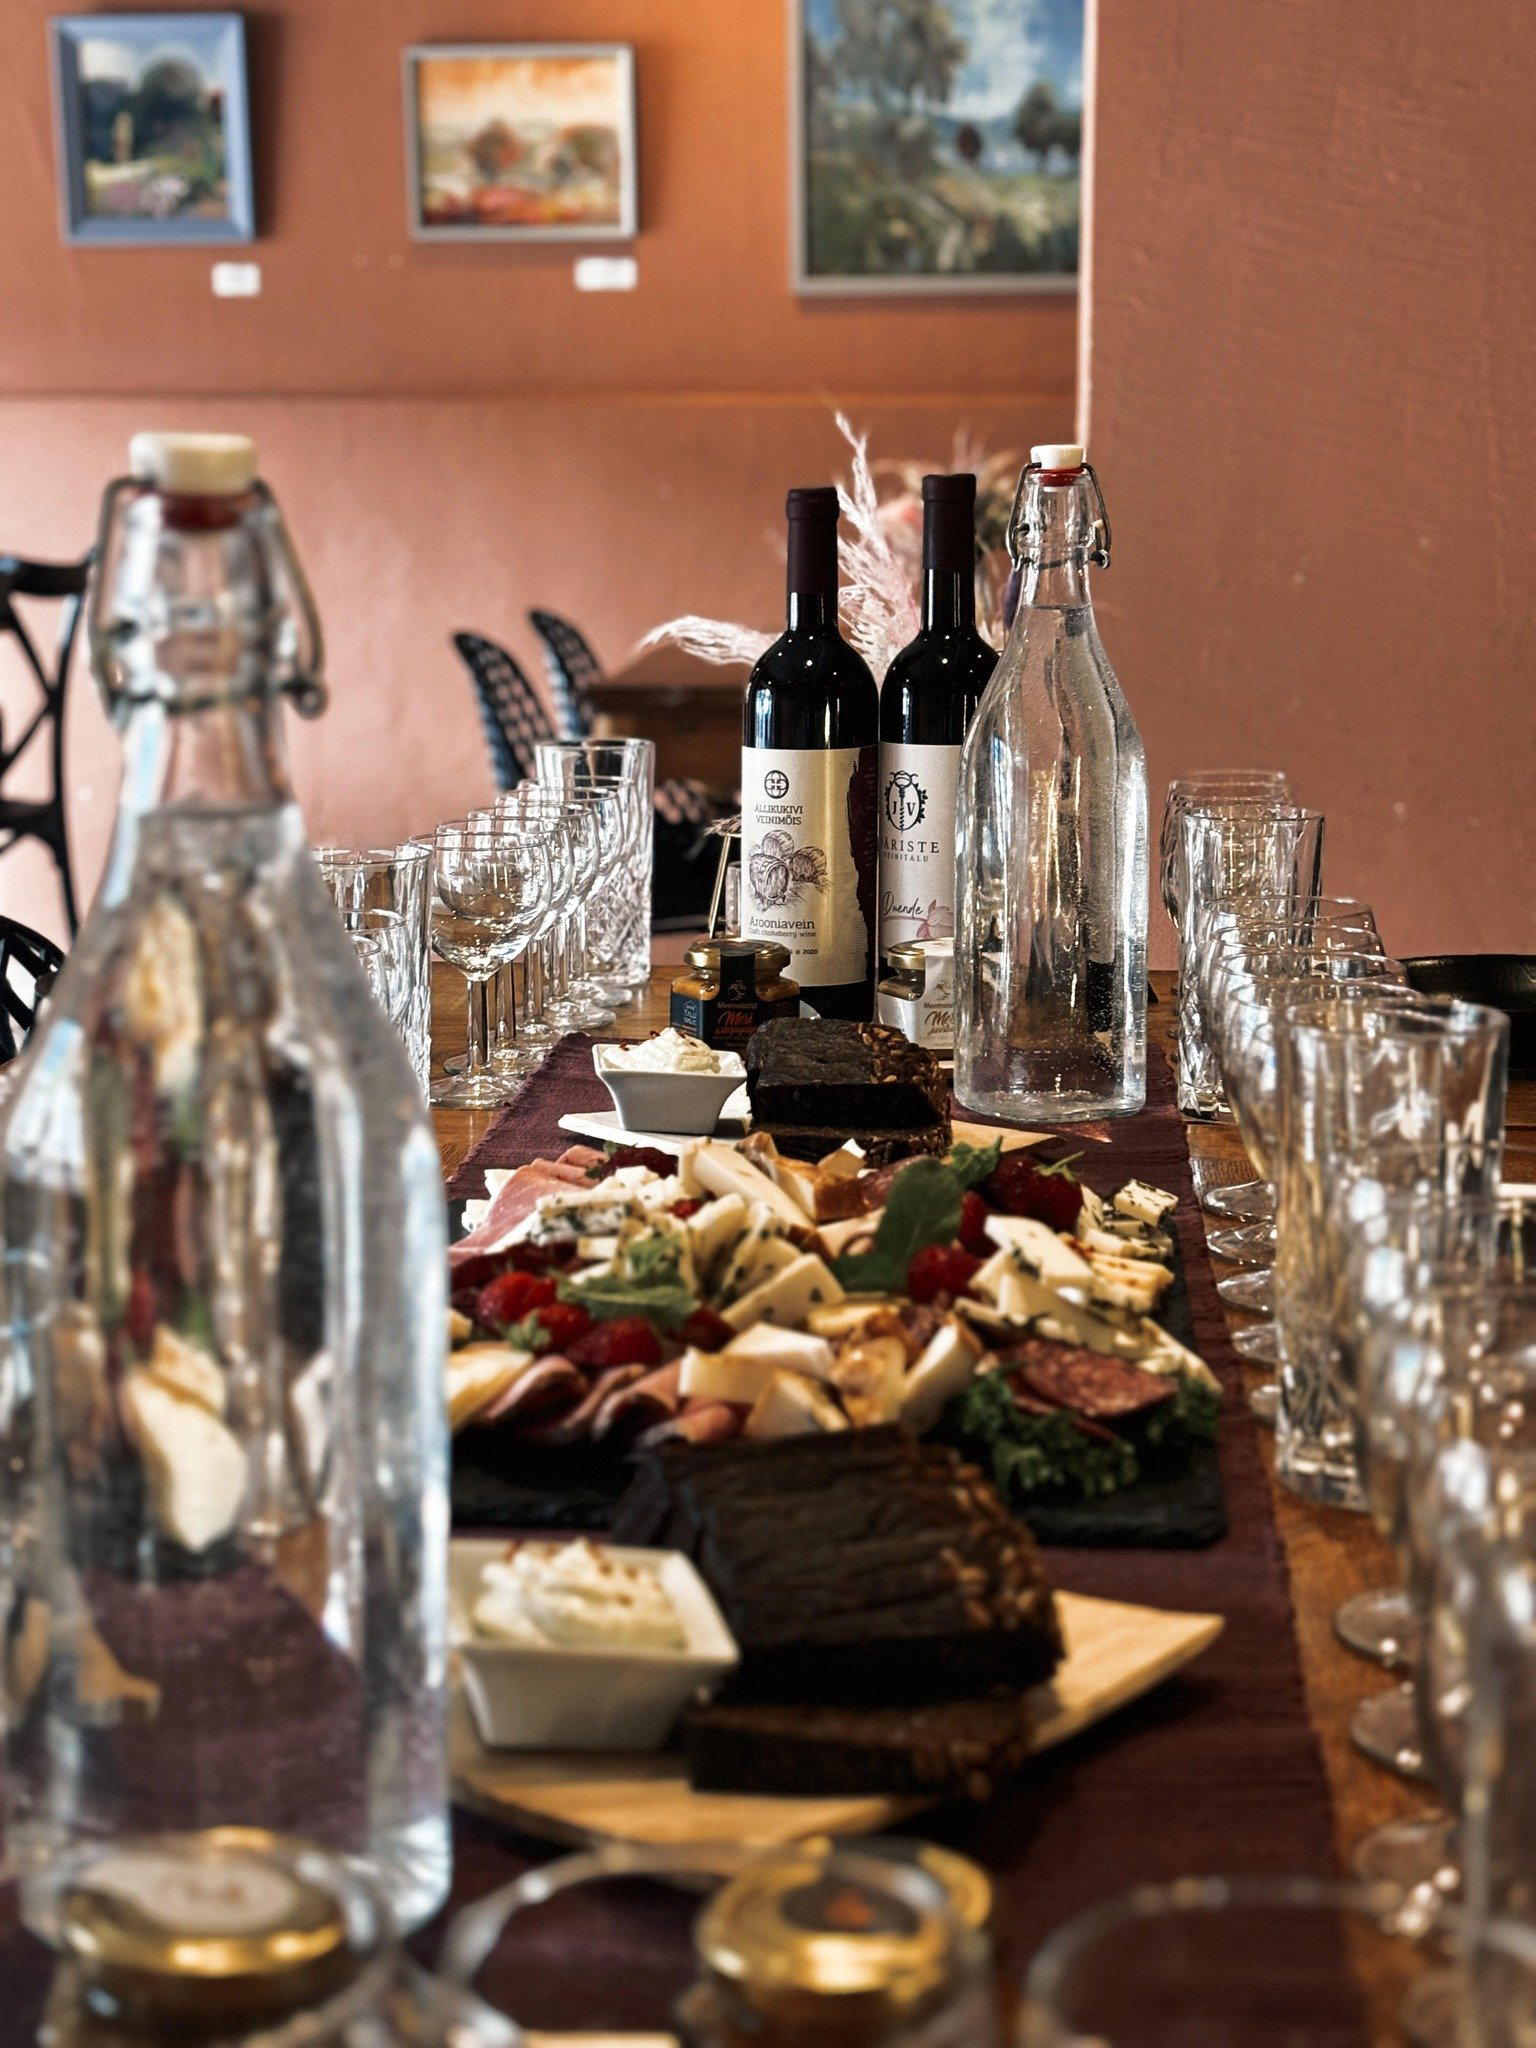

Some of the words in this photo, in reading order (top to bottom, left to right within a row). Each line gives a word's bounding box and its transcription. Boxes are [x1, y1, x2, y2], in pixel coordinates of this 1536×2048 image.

[755, 804, 803, 814] ALLIKUKIVI
[906, 802, 916, 816] V
[756, 814, 802, 826] VEINIMÕIS
[749, 916, 816, 930] Arooniavein
